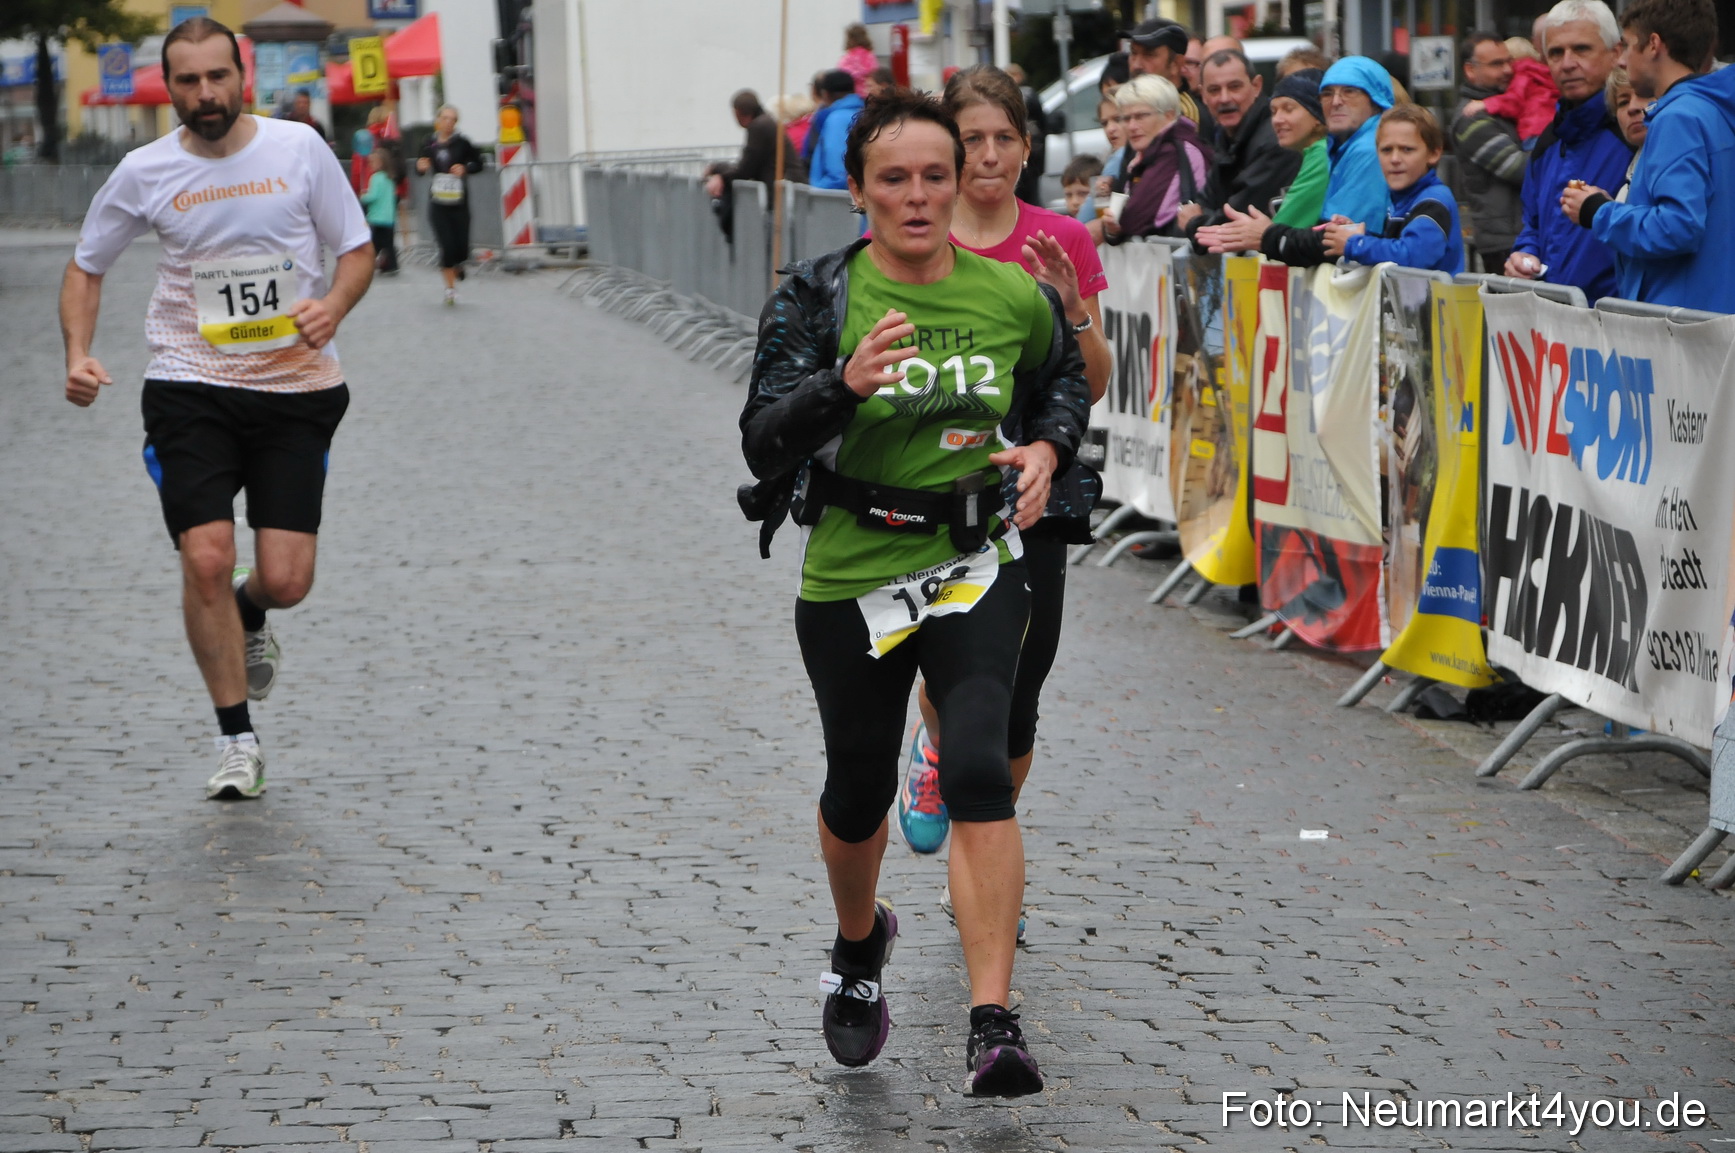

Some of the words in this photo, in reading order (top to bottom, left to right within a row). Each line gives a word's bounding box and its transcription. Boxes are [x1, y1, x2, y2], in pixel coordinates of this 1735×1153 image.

[172, 178, 273, 213] Continental
[194, 270, 229, 280] PARTL
[230, 264, 280, 278] Neumarkt
[218, 278, 280, 317] 154
[229, 325, 275, 340] Günter
[869, 507, 889, 518] PRO
[891, 512, 925, 523] TOUCH
[1487, 483, 1649, 694] HCKNER
[1647, 629, 1696, 676] 92318
